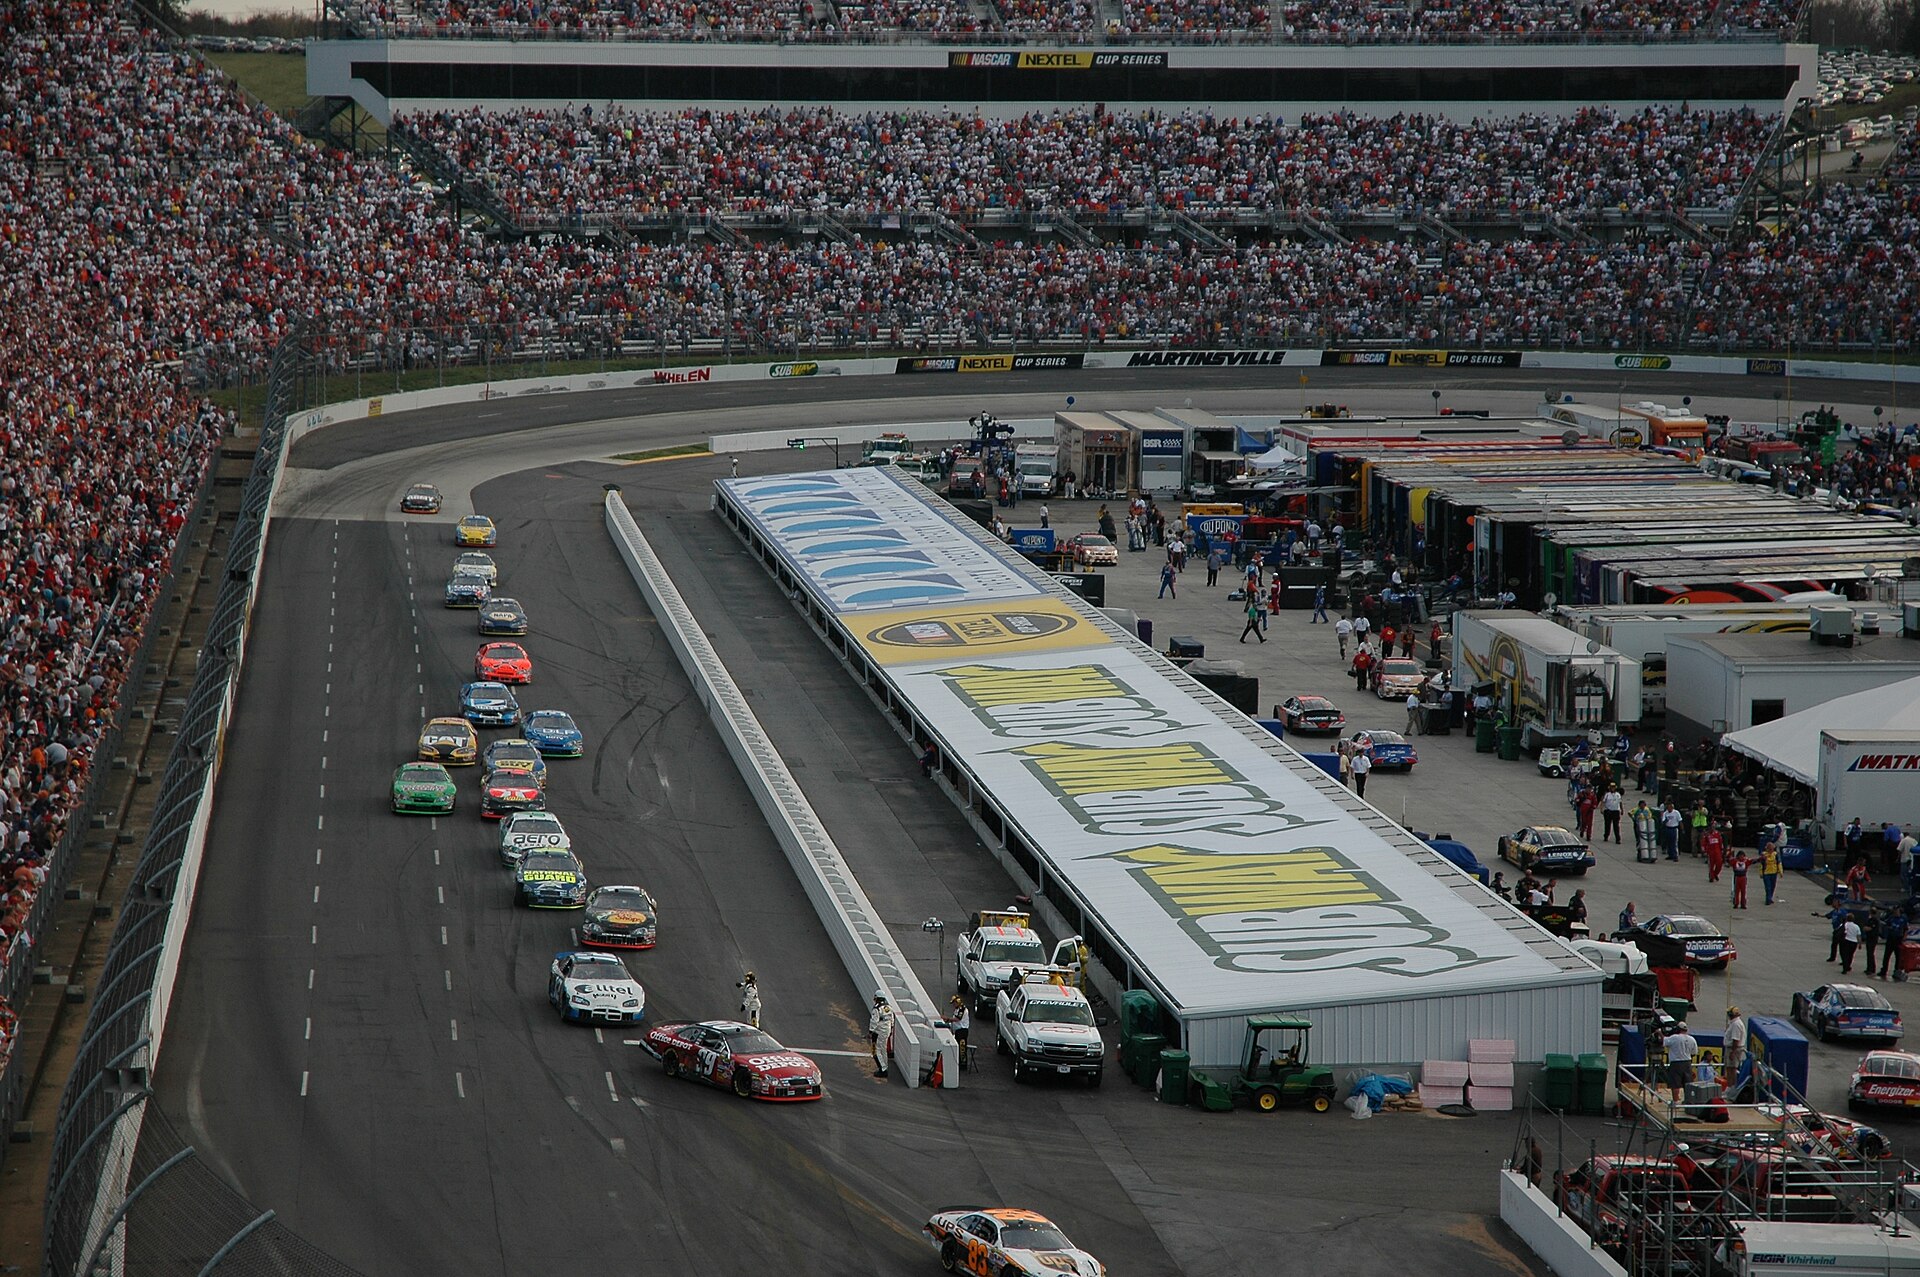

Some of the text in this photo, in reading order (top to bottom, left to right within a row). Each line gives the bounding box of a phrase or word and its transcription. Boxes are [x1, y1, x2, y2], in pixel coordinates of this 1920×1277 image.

[971, 54, 1162, 66] NASCAR NEXTEL CUP SERIES
[926, 357, 1066, 370] NASCAR NEXTEL CUP SERIES
[1127, 351, 1287, 366] MARTINSVILLE
[1353, 354, 1385, 364] NASCAR
[1449, 355, 1468, 364] CUP
[1470, 355, 1504, 364] SERIES
[1618, 356, 1668, 368] SUBWAY
[654, 367, 711, 384] WHELEN
[772, 363, 817, 377] SUBWAY
[1143, 439, 1162, 448] BSR
[907, 665, 1210, 736] SUBWAY
[977, 741, 1338, 836] SUBWAY
[513, 834, 561, 845] aero
[524, 875, 576, 884] GUARD
[1073, 843, 1517, 976] SUBWAY
[1686, 942, 1723, 951] Valvoline
[1029, 1000, 1085, 1008] CHEVROLET
[650, 1031, 693, 1051] Office DEPOT
[748, 1055, 808, 1065] Office
[755, 1062, 811, 1072] DEPOT
[1868, 1084, 1915, 1097] Energizer
[937, 1216, 964, 1240] UPS
[1752, 1253, 1836, 1265] ELGIN Whirlwind
